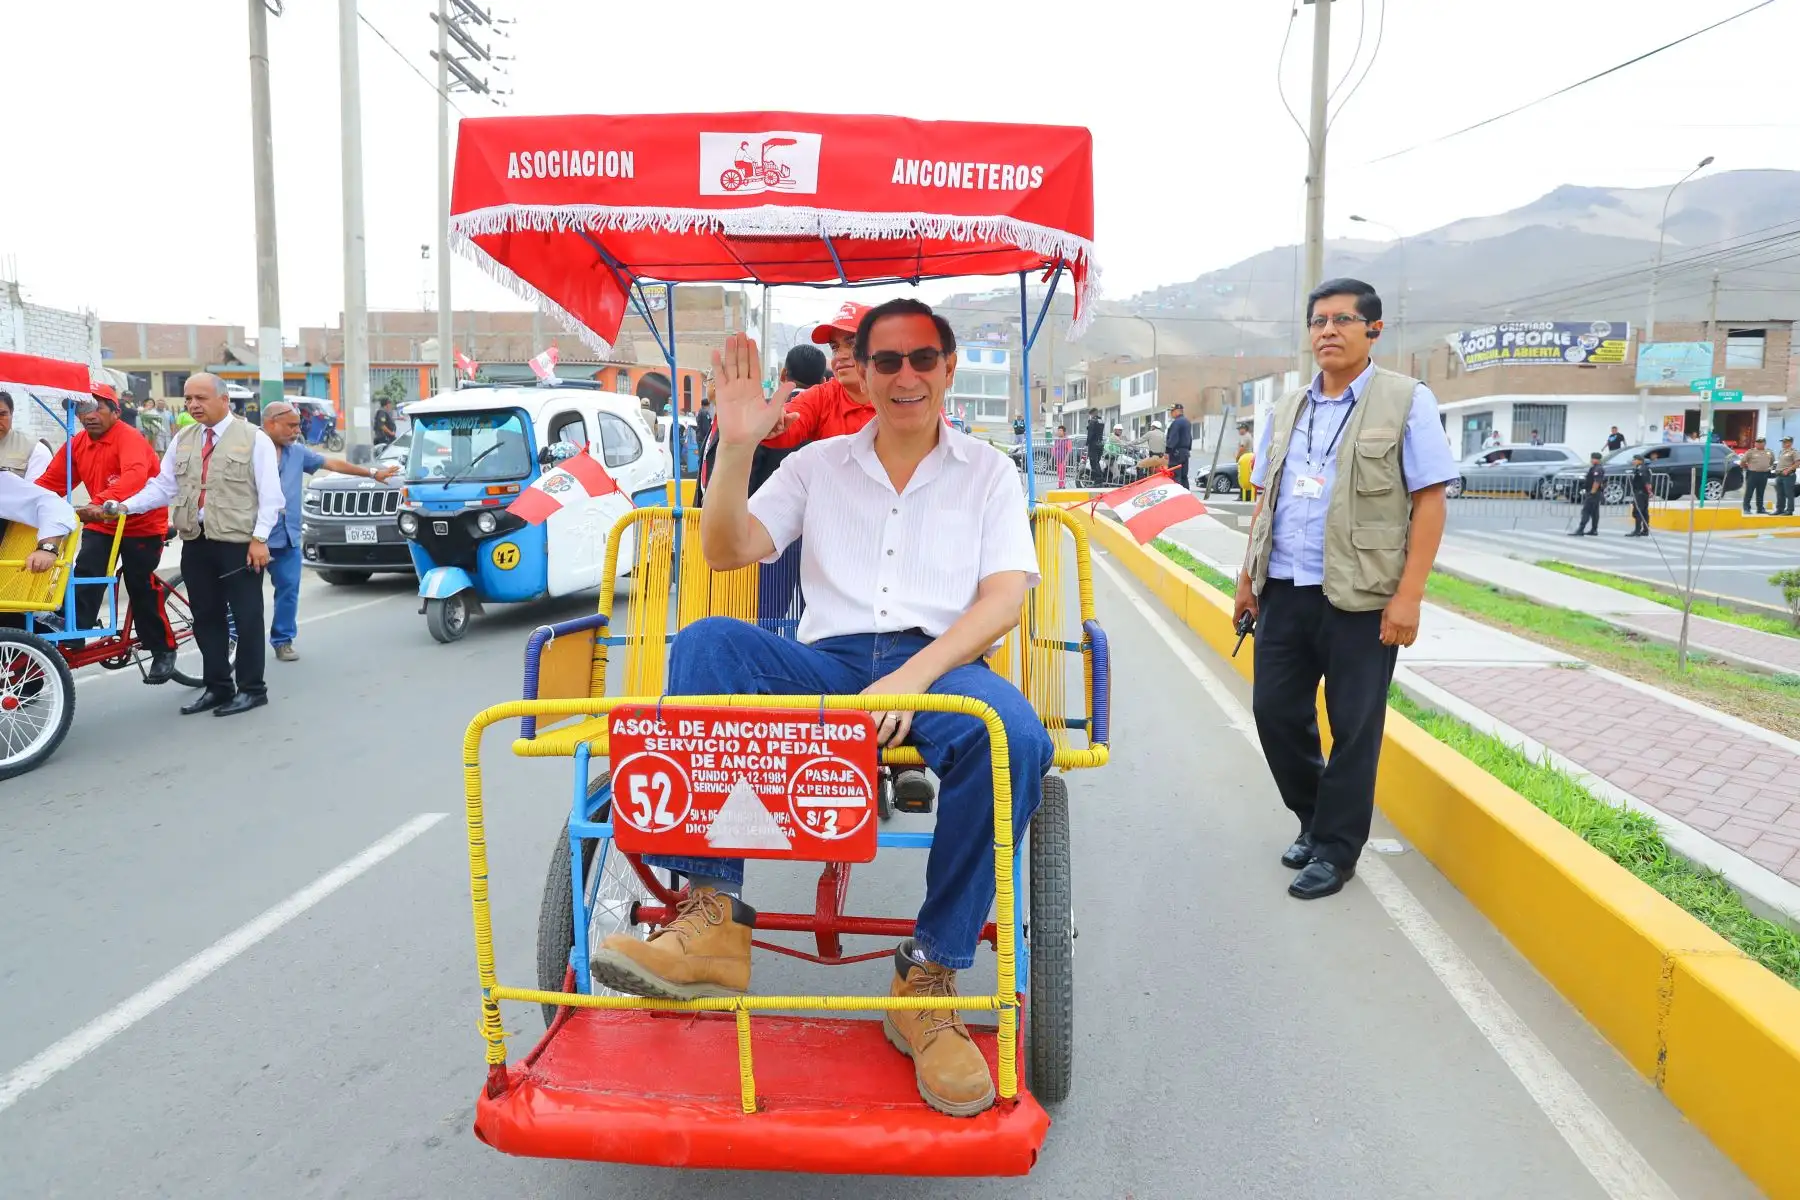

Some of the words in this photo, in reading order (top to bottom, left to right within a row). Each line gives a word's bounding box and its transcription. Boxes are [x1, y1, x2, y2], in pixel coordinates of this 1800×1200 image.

[507, 150, 634, 179] ASOCIACION
[891, 158, 1044, 191] ANCONETEROS
[1502, 331, 1571, 346] PEOPLE
[1513, 346, 1561, 358] ABIERTA
[496, 549, 515, 565] 47
[613, 719, 673, 736] ASOC.
[679, 720, 706, 737] DE
[711, 721, 866, 741] ANCONETEROS
[645, 737, 740, 753] SERVICIO
[747, 740, 761, 753] A
[767, 741, 834, 756] PEDAL
[691, 754, 715, 769] DE
[720, 755, 787, 771] ANCON
[691, 770, 729, 782] FUNDO
[805, 769, 855, 783] PASAJE
[694, 782, 735, 794] SERVICIO
[807, 785, 864, 796] PERSONA
[629, 771, 675, 827] 52
